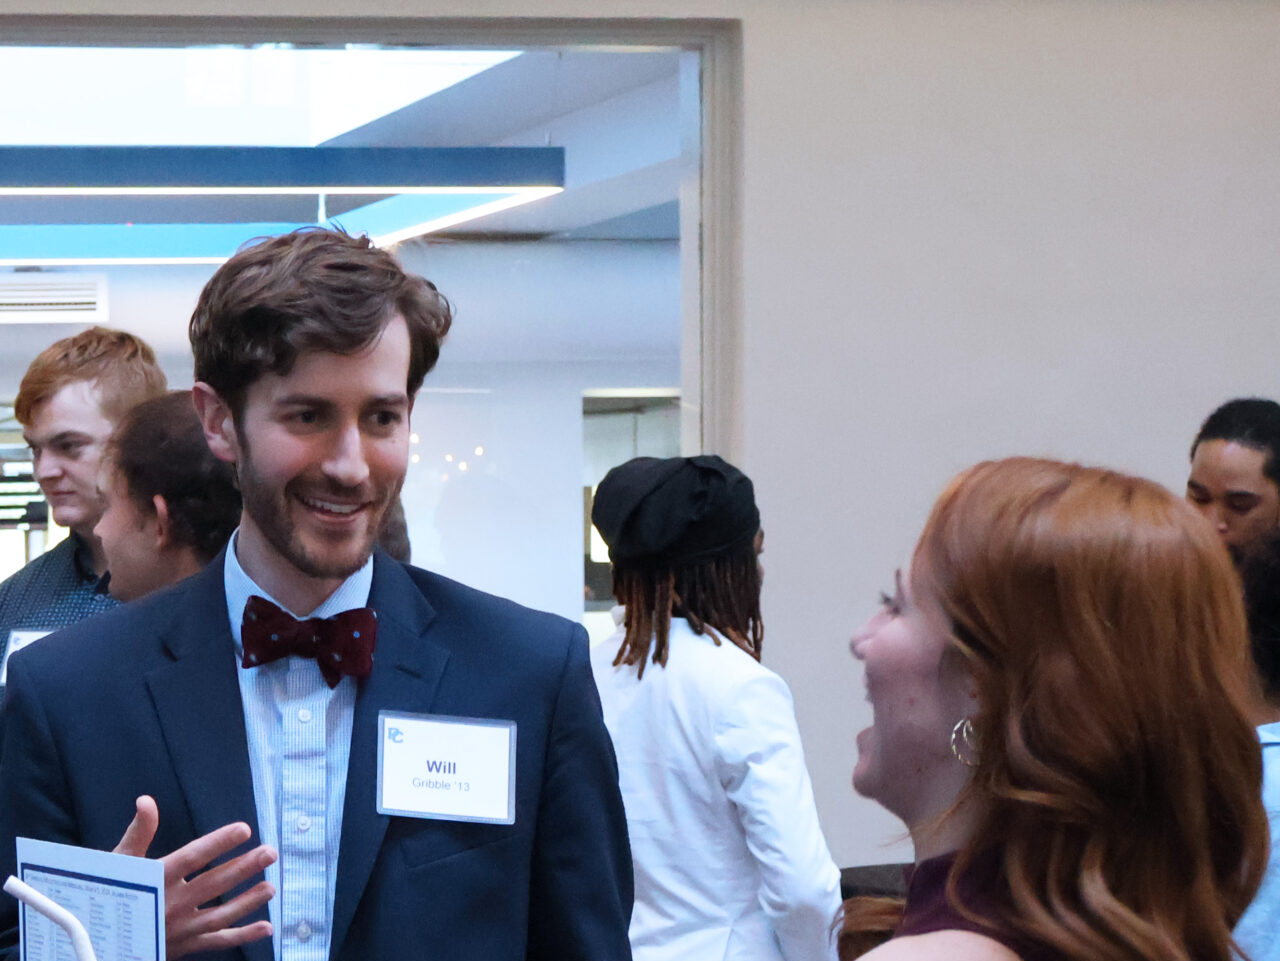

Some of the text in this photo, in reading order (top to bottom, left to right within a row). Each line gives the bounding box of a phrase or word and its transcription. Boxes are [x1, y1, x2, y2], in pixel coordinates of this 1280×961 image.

[426, 759, 457, 775] Will
[412, 777, 471, 792] Gribble '13
